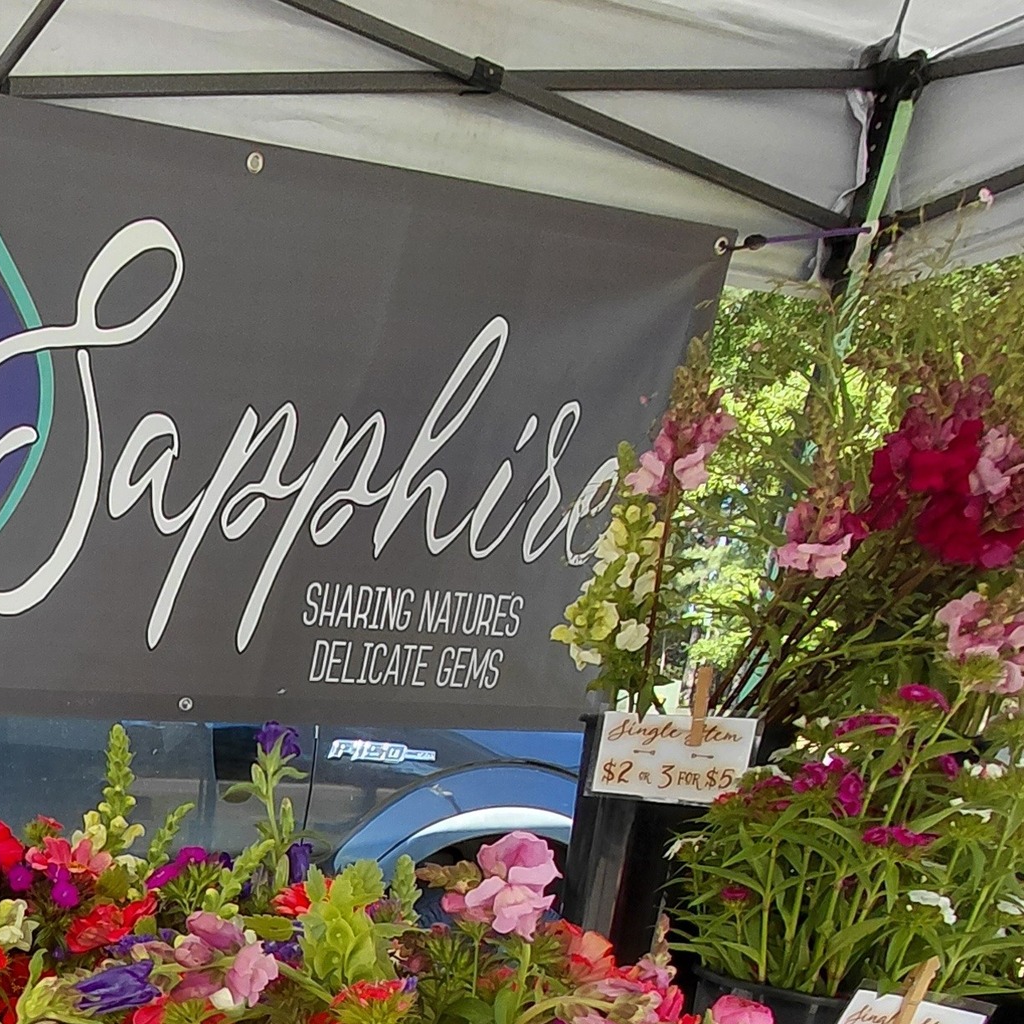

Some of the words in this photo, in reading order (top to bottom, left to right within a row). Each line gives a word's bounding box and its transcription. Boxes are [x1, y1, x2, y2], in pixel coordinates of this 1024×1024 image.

[302, 582, 415, 631] SHARING
[308, 639, 434, 686] DELICATE
[435, 646, 504, 689] GEMS
[607, 719, 681, 745] Single
[601, 759, 633, 785] $2
[638, 771, 651, 785] OR
[658, 765, 675, 789] 3
[677, 771, 702, 790] FOR
[705, 767, 735, 790] $5
